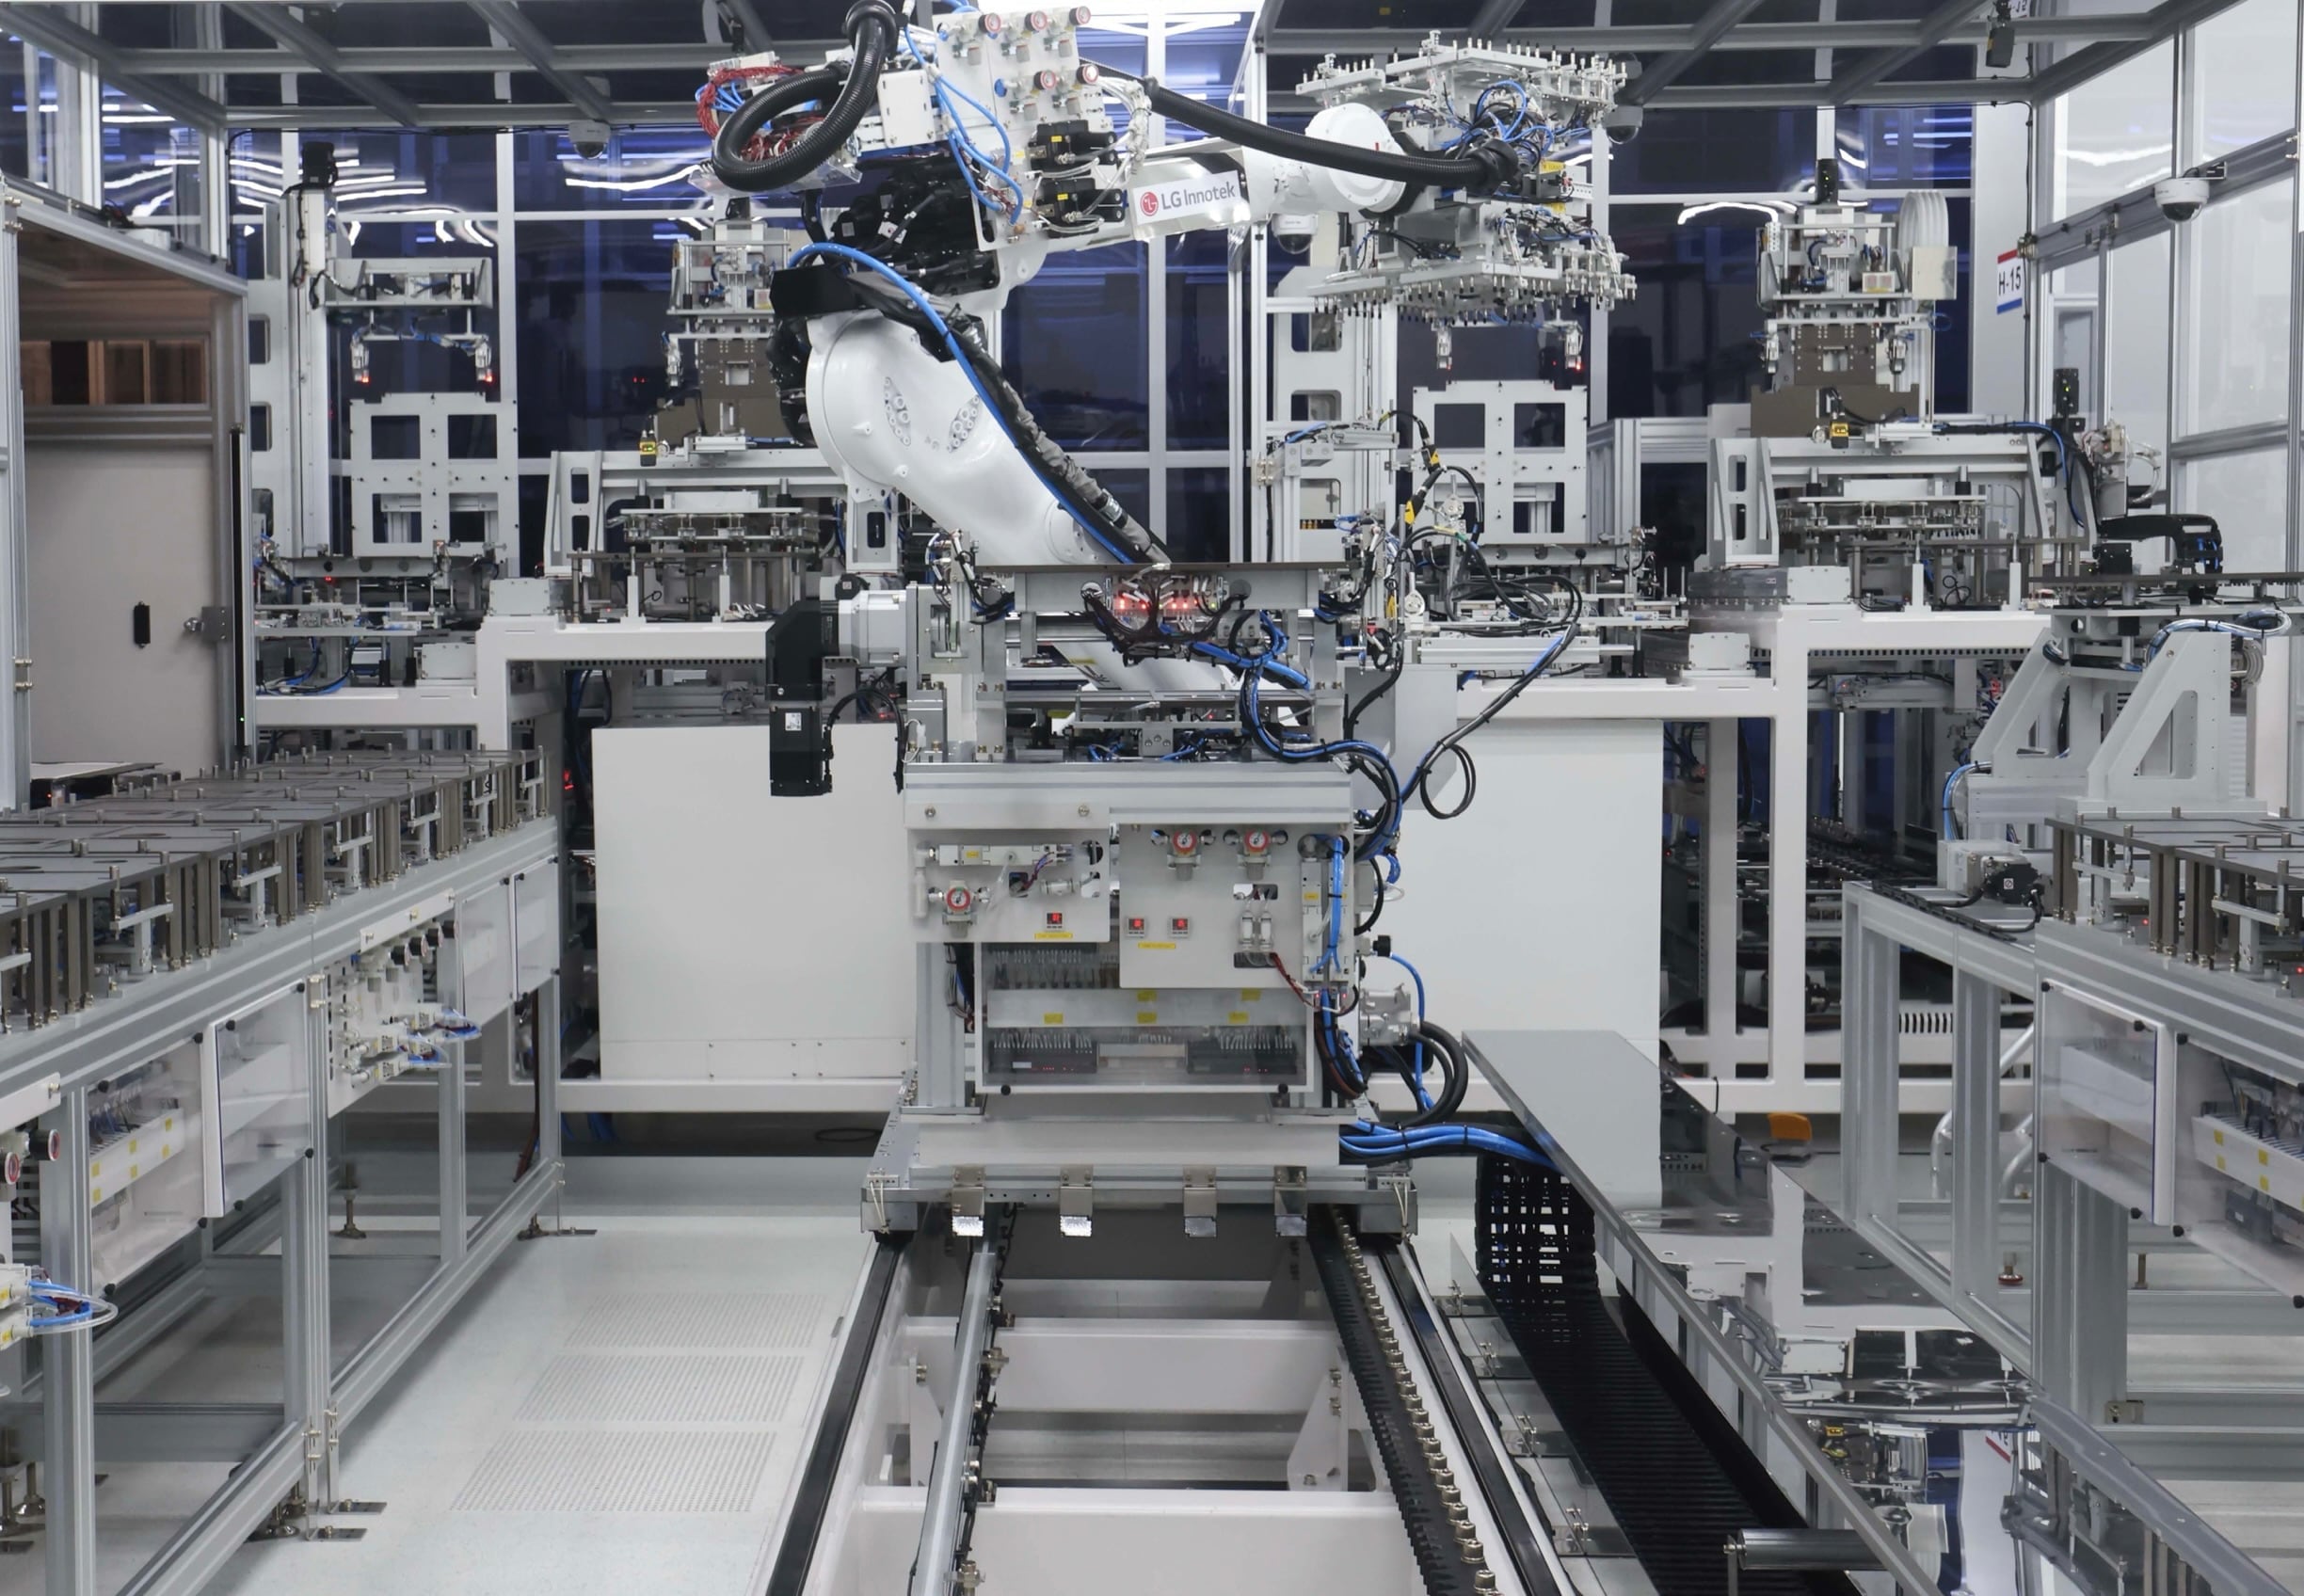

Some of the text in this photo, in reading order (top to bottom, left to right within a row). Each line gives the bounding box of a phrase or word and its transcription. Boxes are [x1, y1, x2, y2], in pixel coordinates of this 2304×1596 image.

[1160, 182, 1236, 210] LG Innotek
[1998, 265, 2022, 296] H-15
